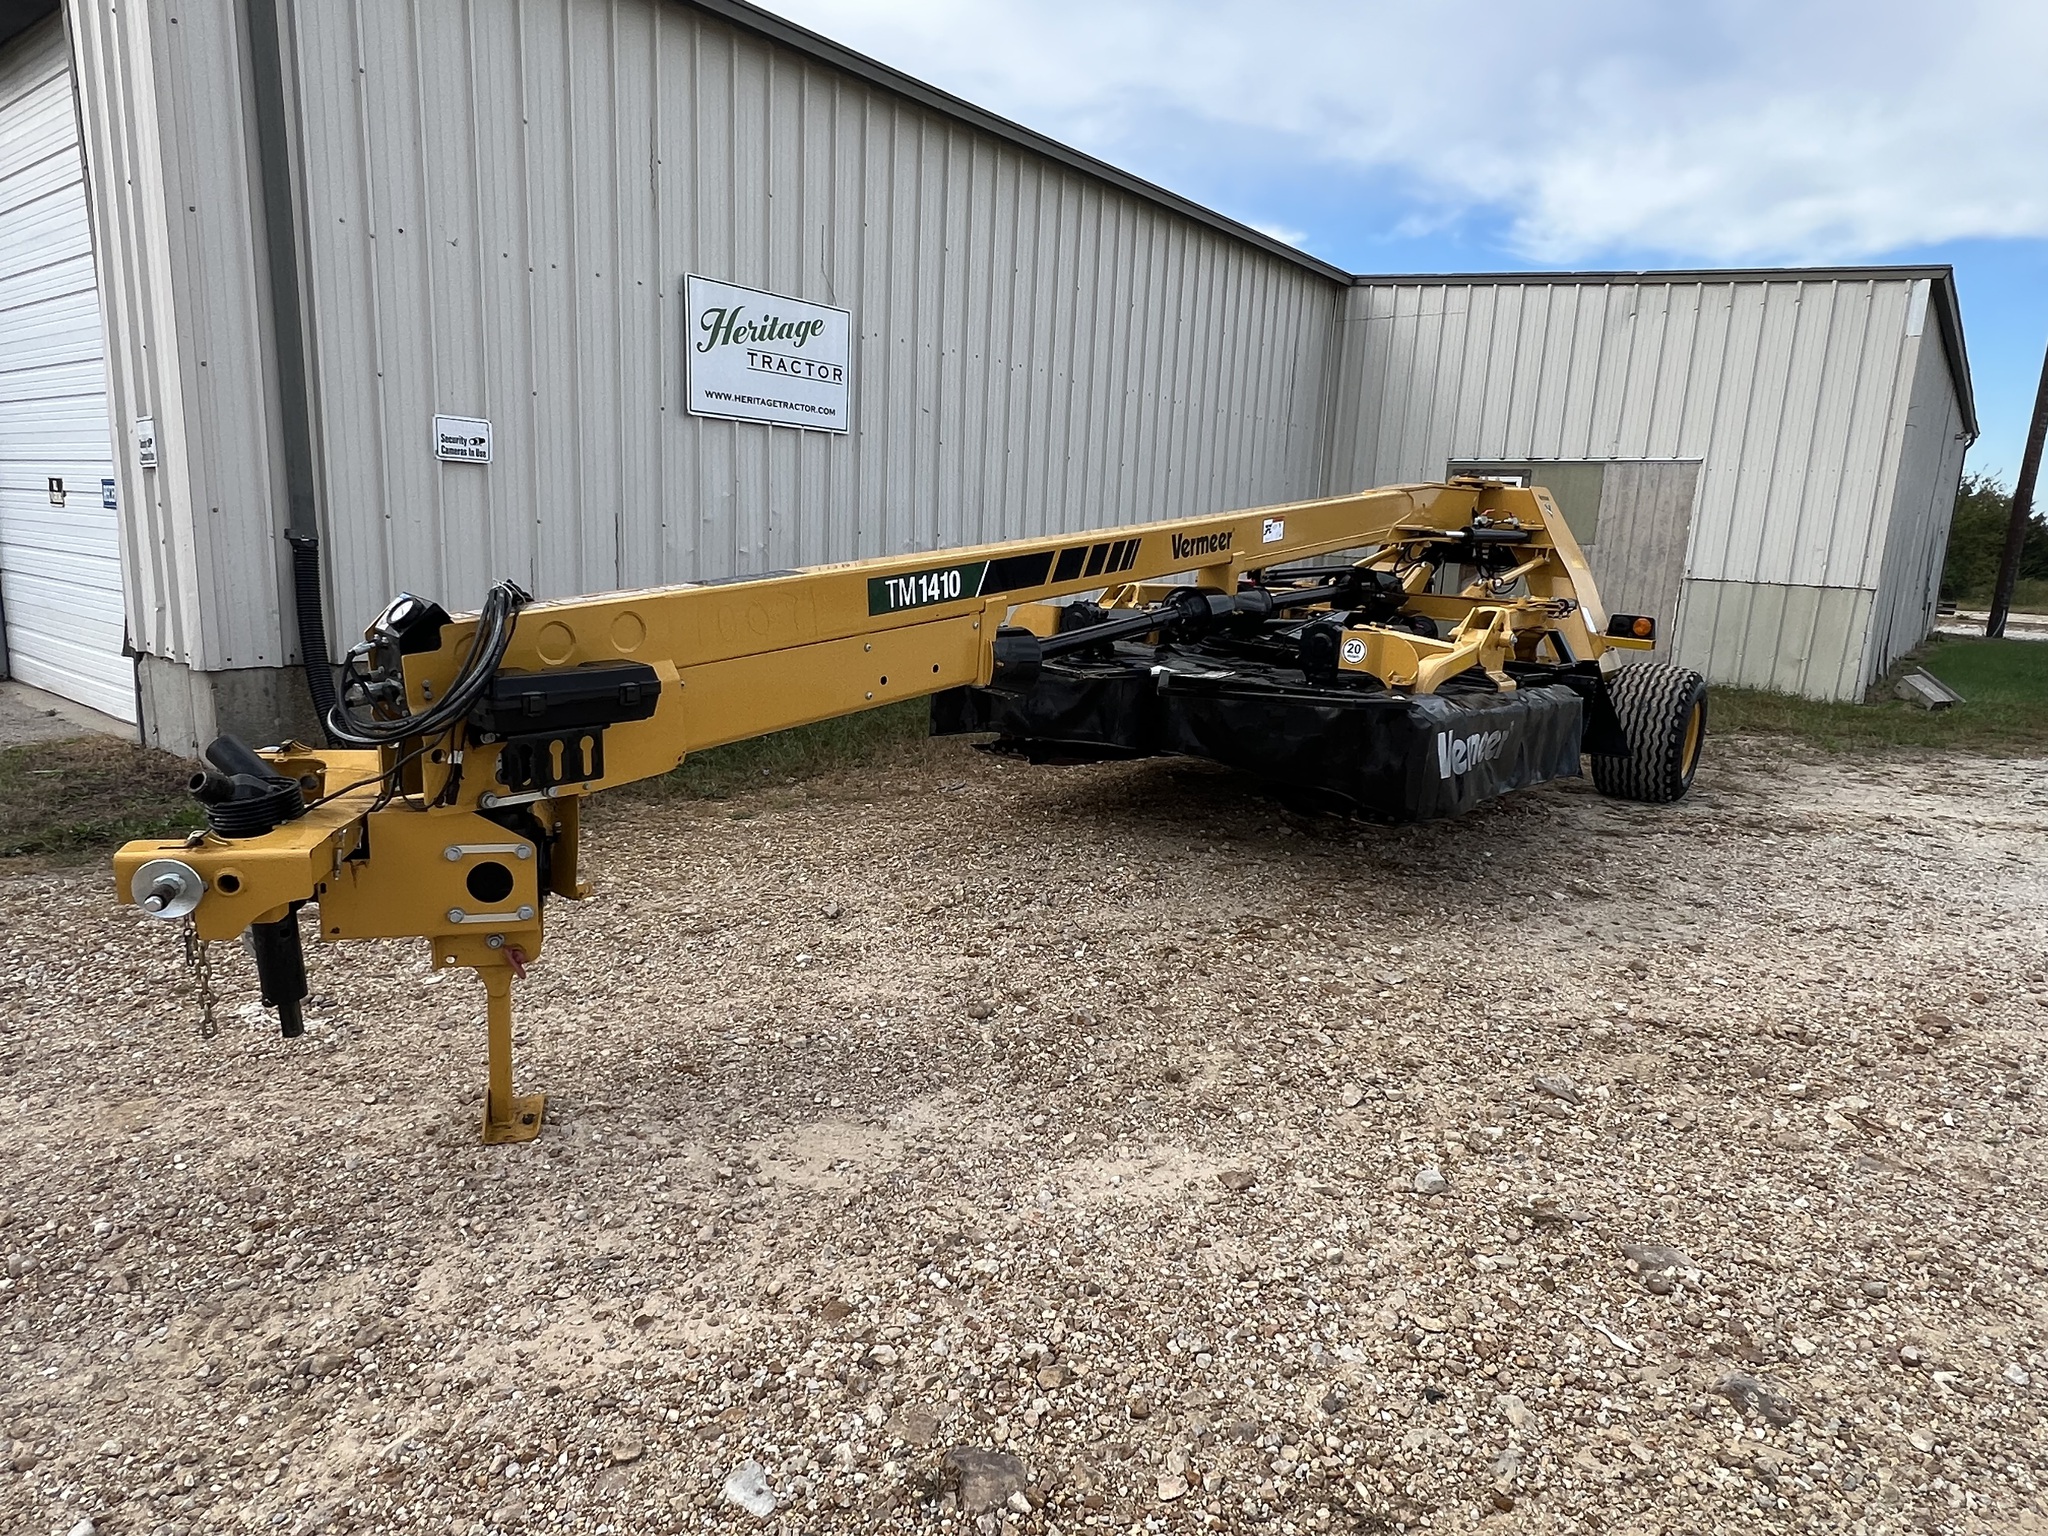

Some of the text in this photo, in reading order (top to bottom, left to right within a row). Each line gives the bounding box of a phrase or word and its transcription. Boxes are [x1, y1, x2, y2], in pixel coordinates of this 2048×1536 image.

[696, 305, 825, 353] Heritage
[746, 351, 843, 382] TRACTOR
[704, 389, 836, 417] WWW.HERITAGETRACTOR.COM
[440, 433, 467, 446] Security
[441, 445, 467, 456] Cameras
[1171, 531, 1233, 560] Vermeer
[1346, 643, 1361, 654] 20
